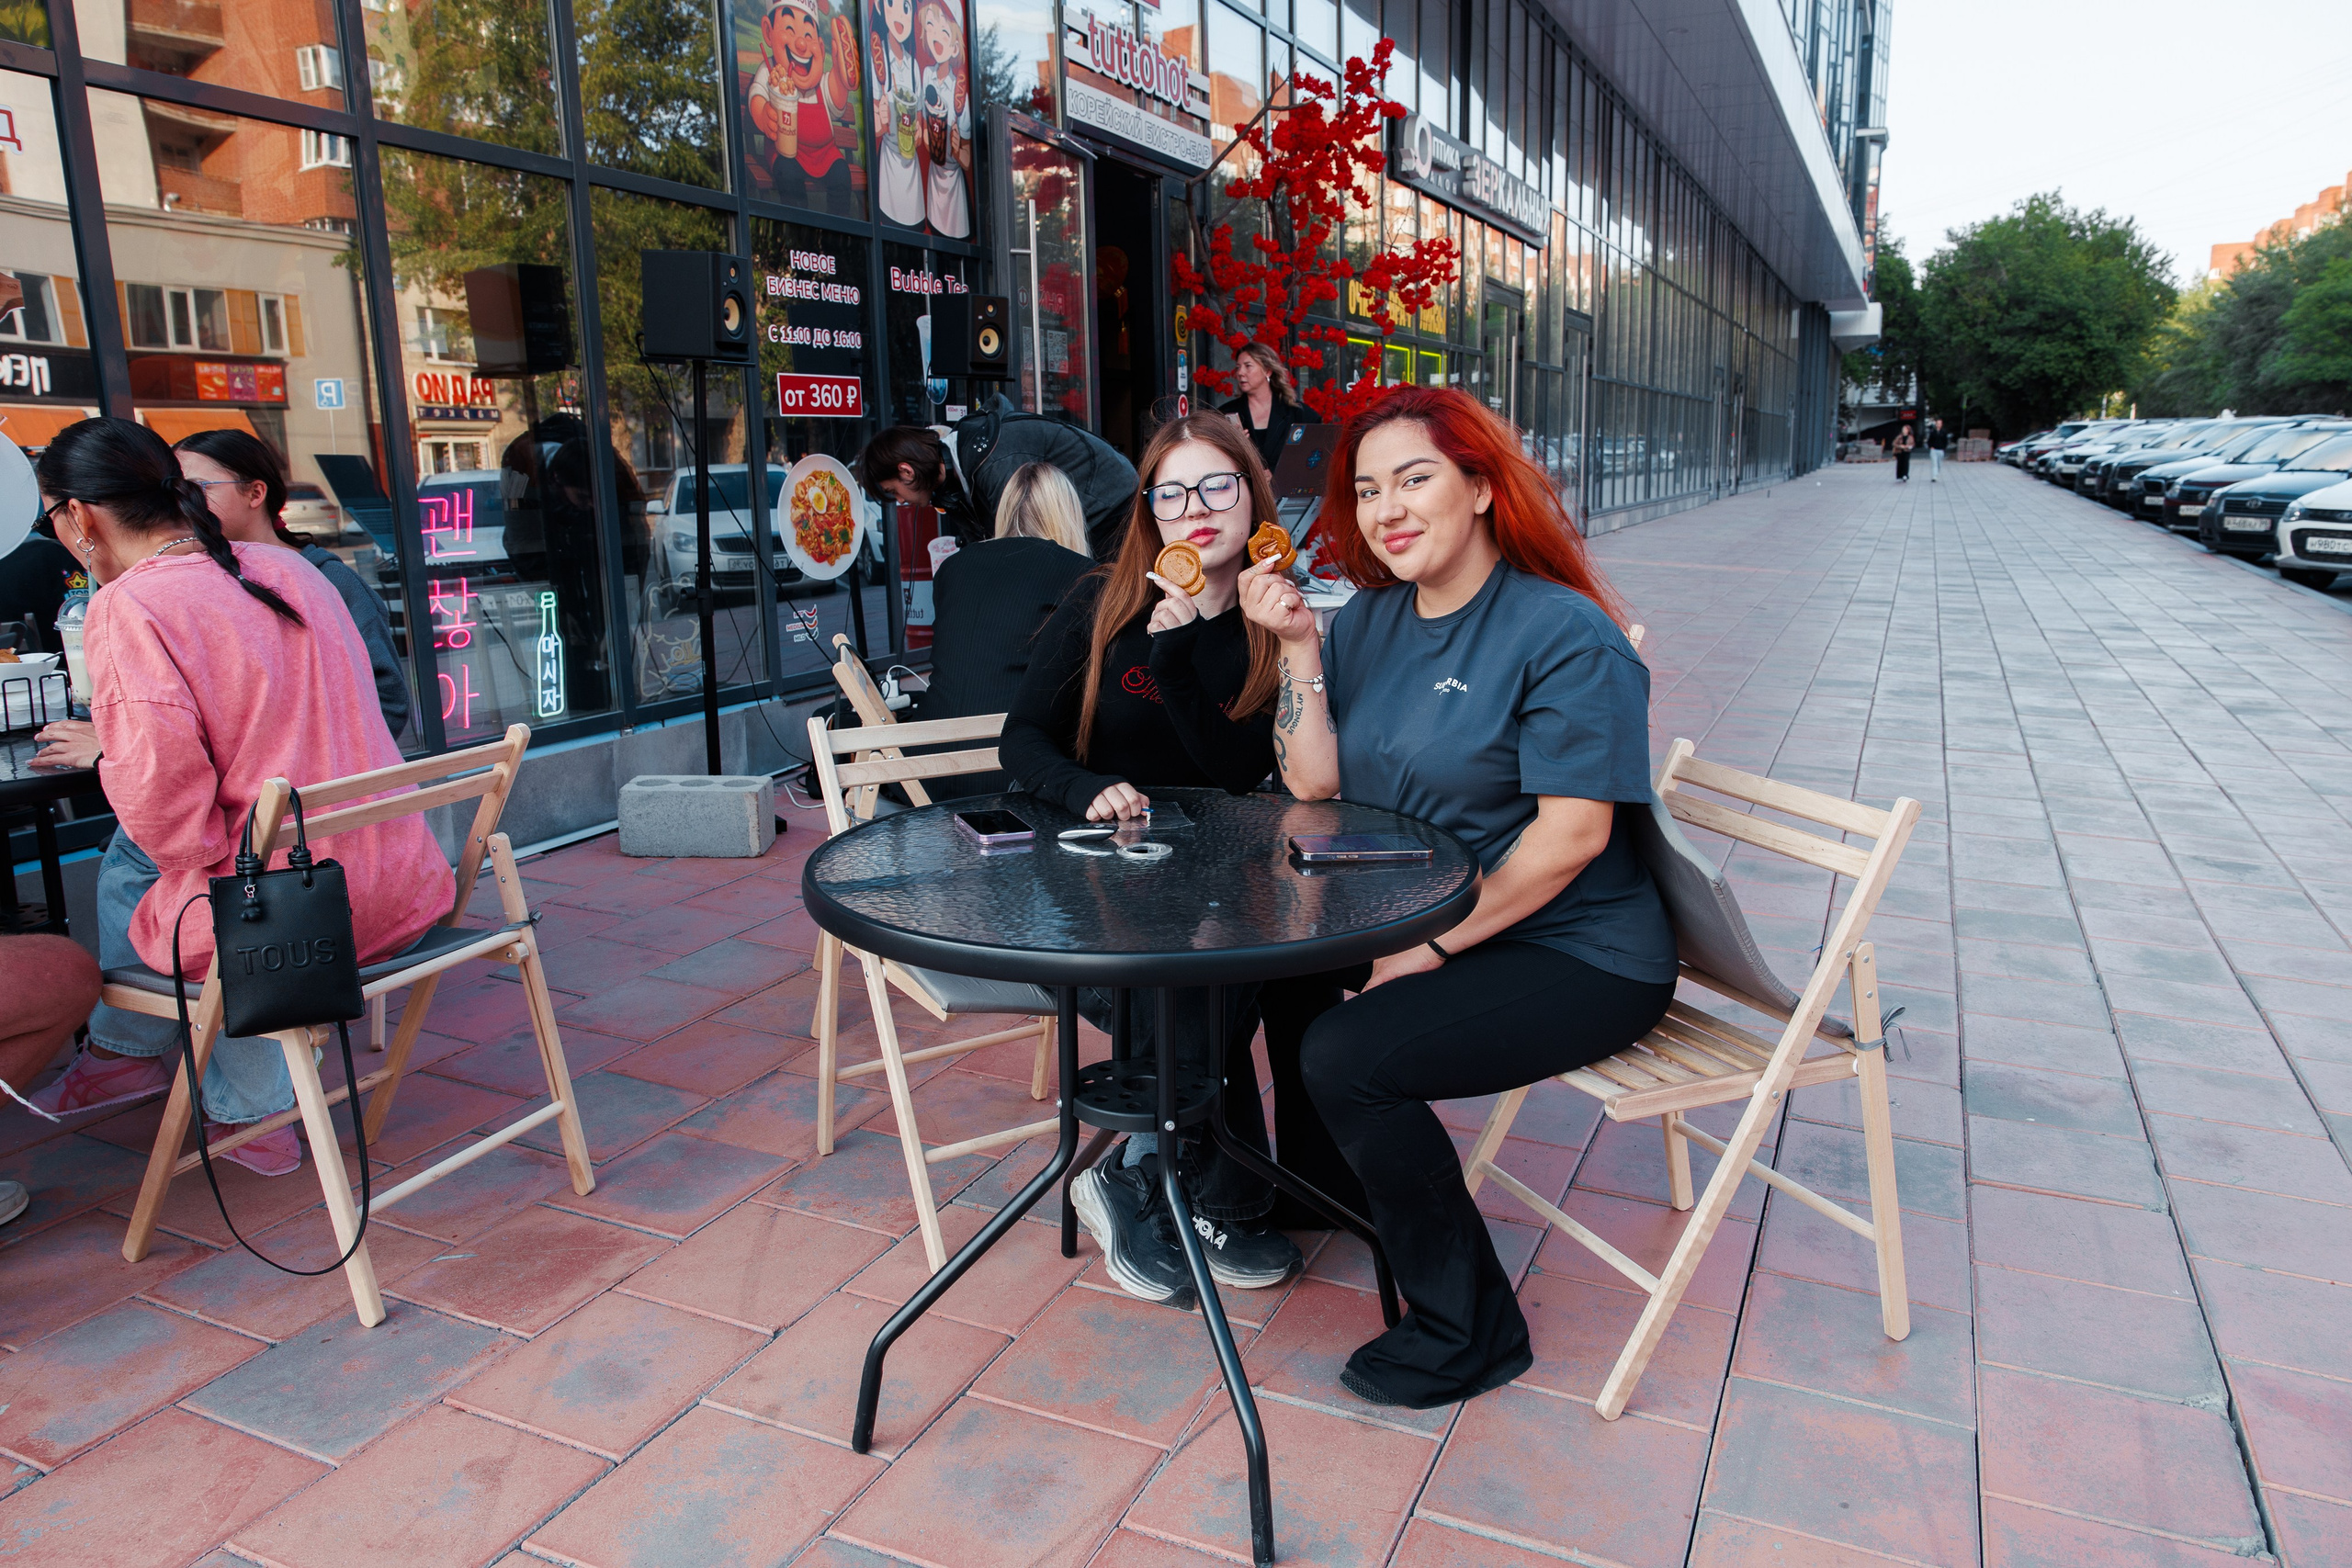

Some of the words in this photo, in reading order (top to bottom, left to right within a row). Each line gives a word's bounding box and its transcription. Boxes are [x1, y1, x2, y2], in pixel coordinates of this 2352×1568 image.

[1087, 11, 1192, 109] tuttohot
[1068, 88, 1143, 141] КОРЕЙСКИЙ
[1145, 120, 1211, 165] БИСТРО-БАР
[1429, 171, 1458, 195] АЛОН
[790, 250, 836, 275] НОВОЕ
[766, 276, 820, 300] БИЗНЕС
[820, 282, 860, 305] МЕНЮ
[890, 266, 943, 294] Bubble
[944, 275, 969, 294] Tea
[780, 325, 811, 344] 11:00
[812, 328, 831, 348] ДО
[833, 330, 862, 348] 16:00
[785, 389, 805, 407] от
[809, 383, 842, 408] 360
[541, 634, 561, 712] 마시자
[1296, 693, 1304, 706] MY
[1286, 706, 1304, 737] TONGUE
[236, 937, 338, 976] TOUS
